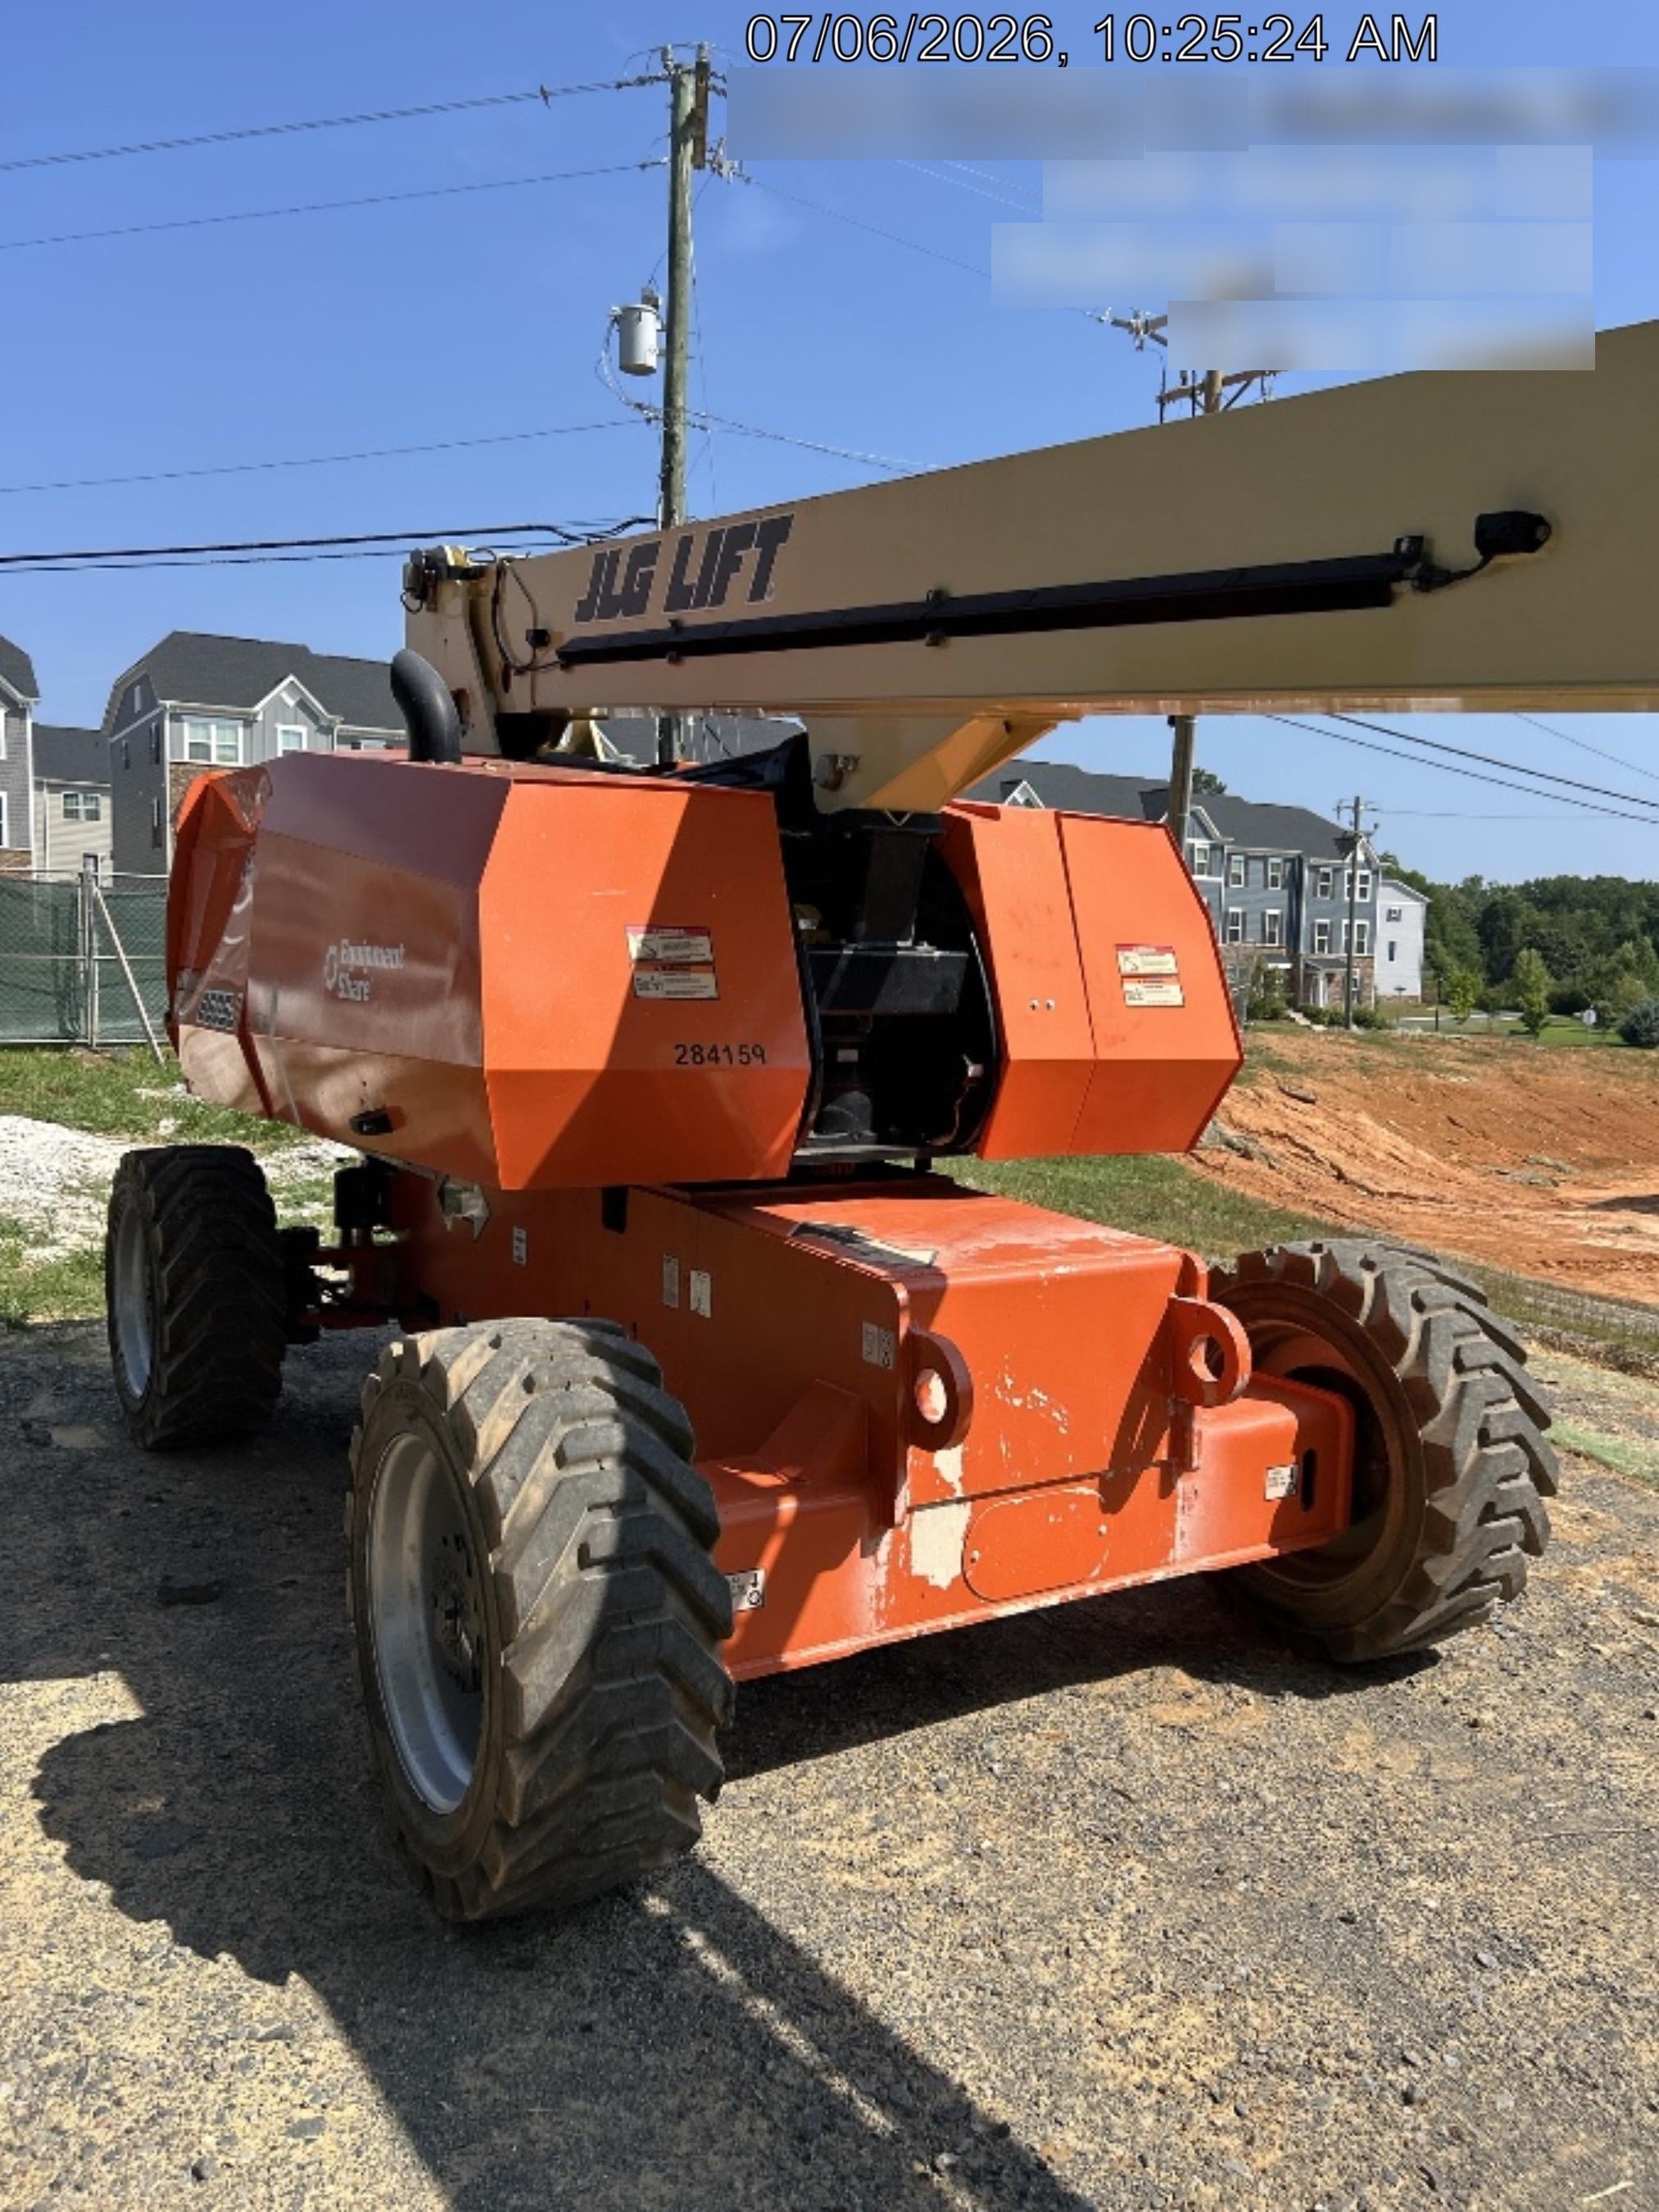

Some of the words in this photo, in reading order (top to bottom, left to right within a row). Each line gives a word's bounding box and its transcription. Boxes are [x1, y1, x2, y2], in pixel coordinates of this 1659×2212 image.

[575, 540, 662, 623] JLG
[662, 512, 795, 613] LIFT
[674, 1043, 768, 1066] 284159
